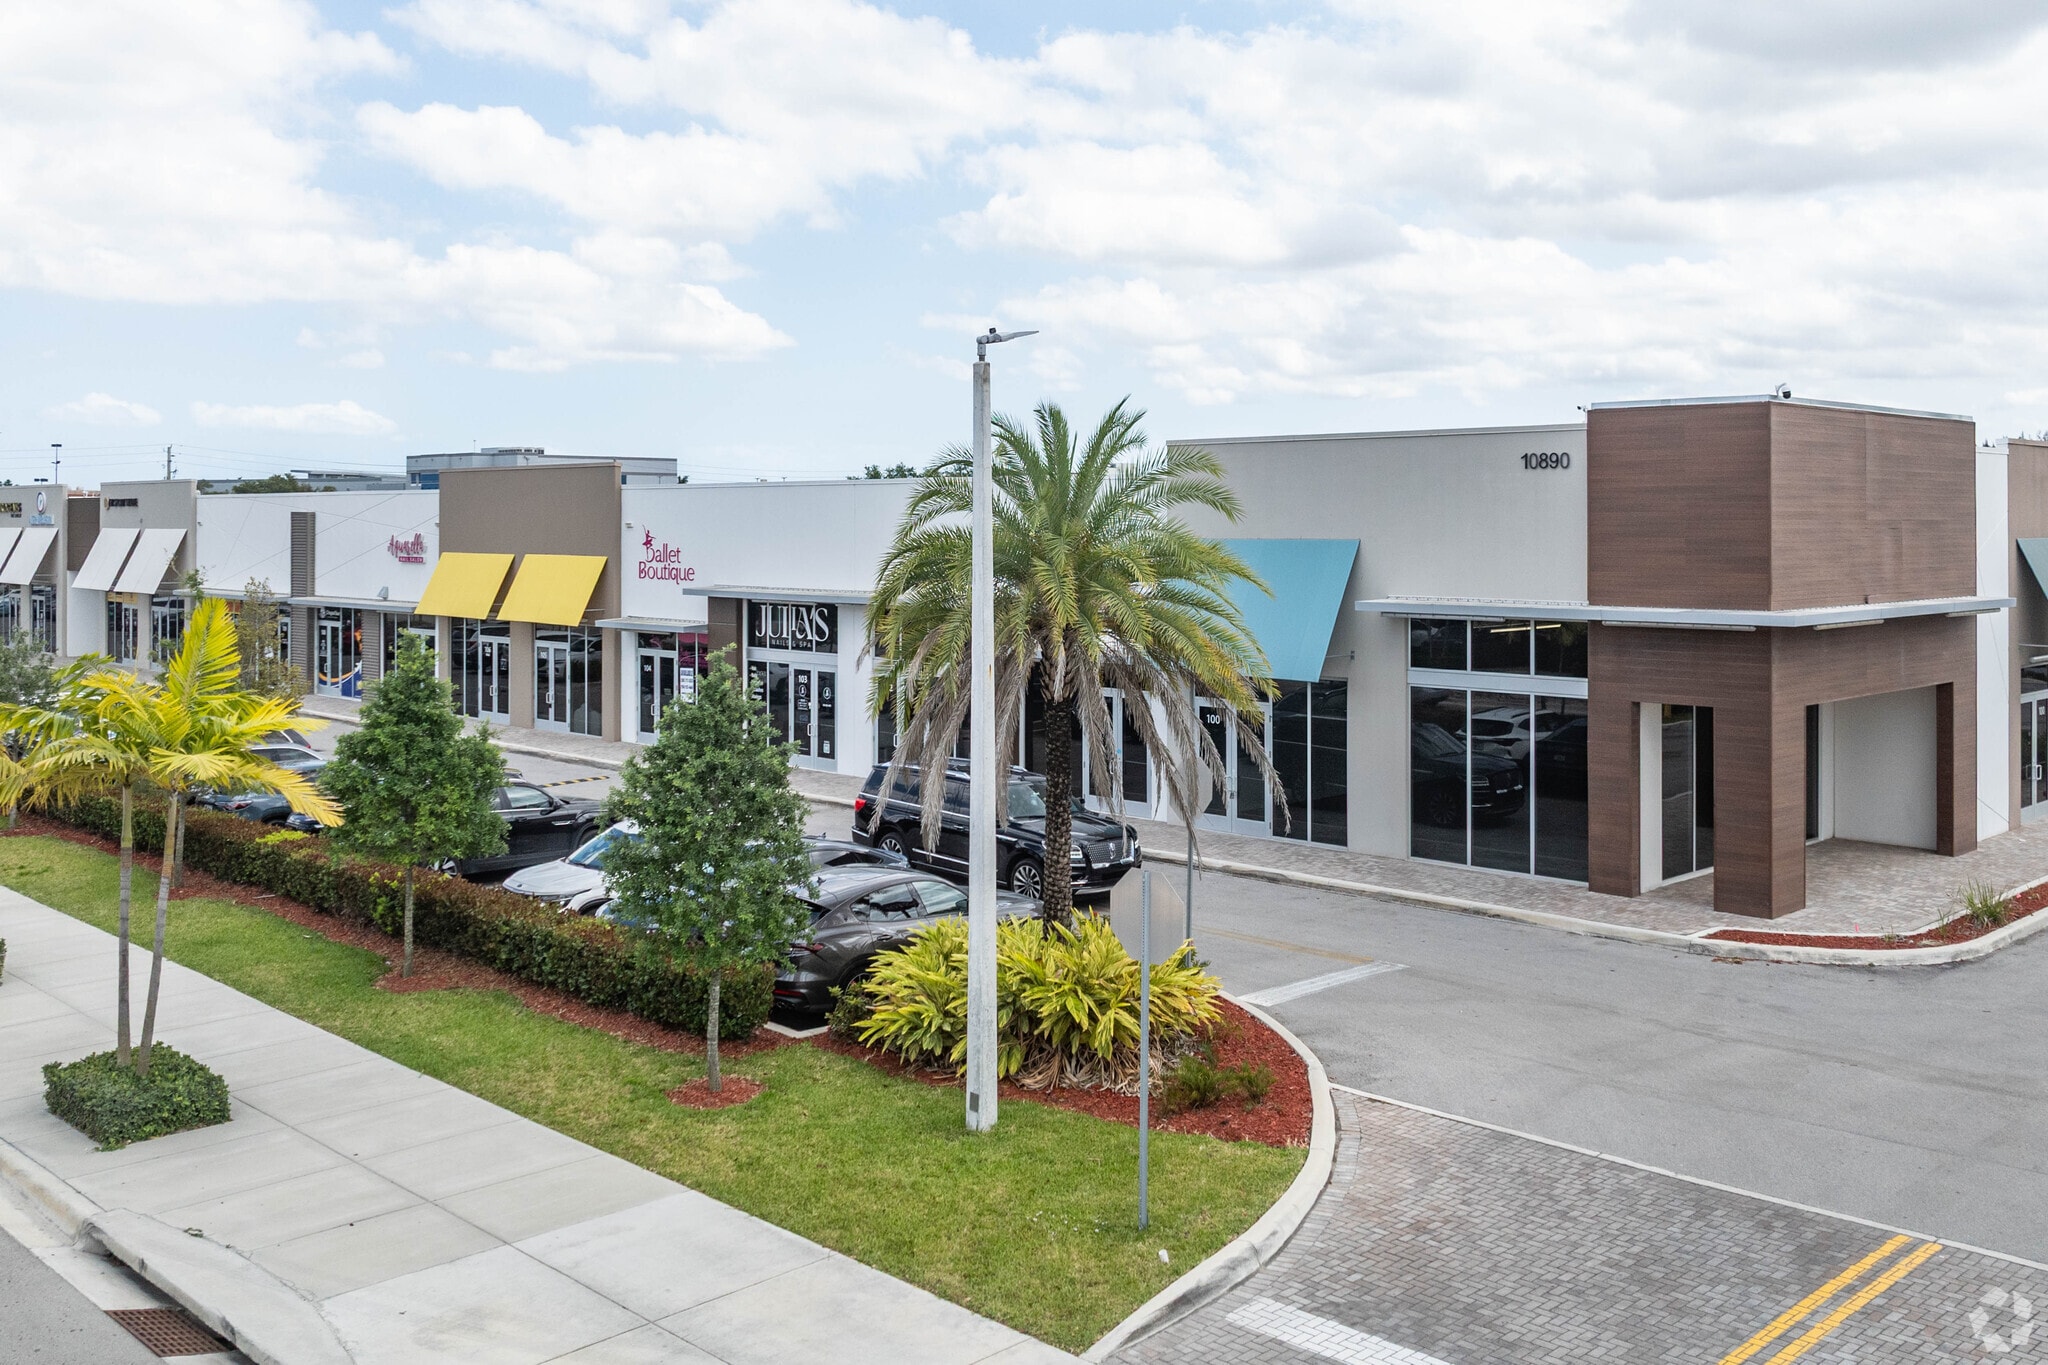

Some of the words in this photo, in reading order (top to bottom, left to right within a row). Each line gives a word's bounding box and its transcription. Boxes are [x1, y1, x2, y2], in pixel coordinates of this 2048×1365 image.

[1520, 452, 1570, 469] 10890
[643, 541, 681, 563] Ballet
[639, 561, 695, 585] Boutique
[771, 639, 790, 647] NAILS
[798, 675, 808, 684] 103
[1206, 714, 1221, 724] 100
